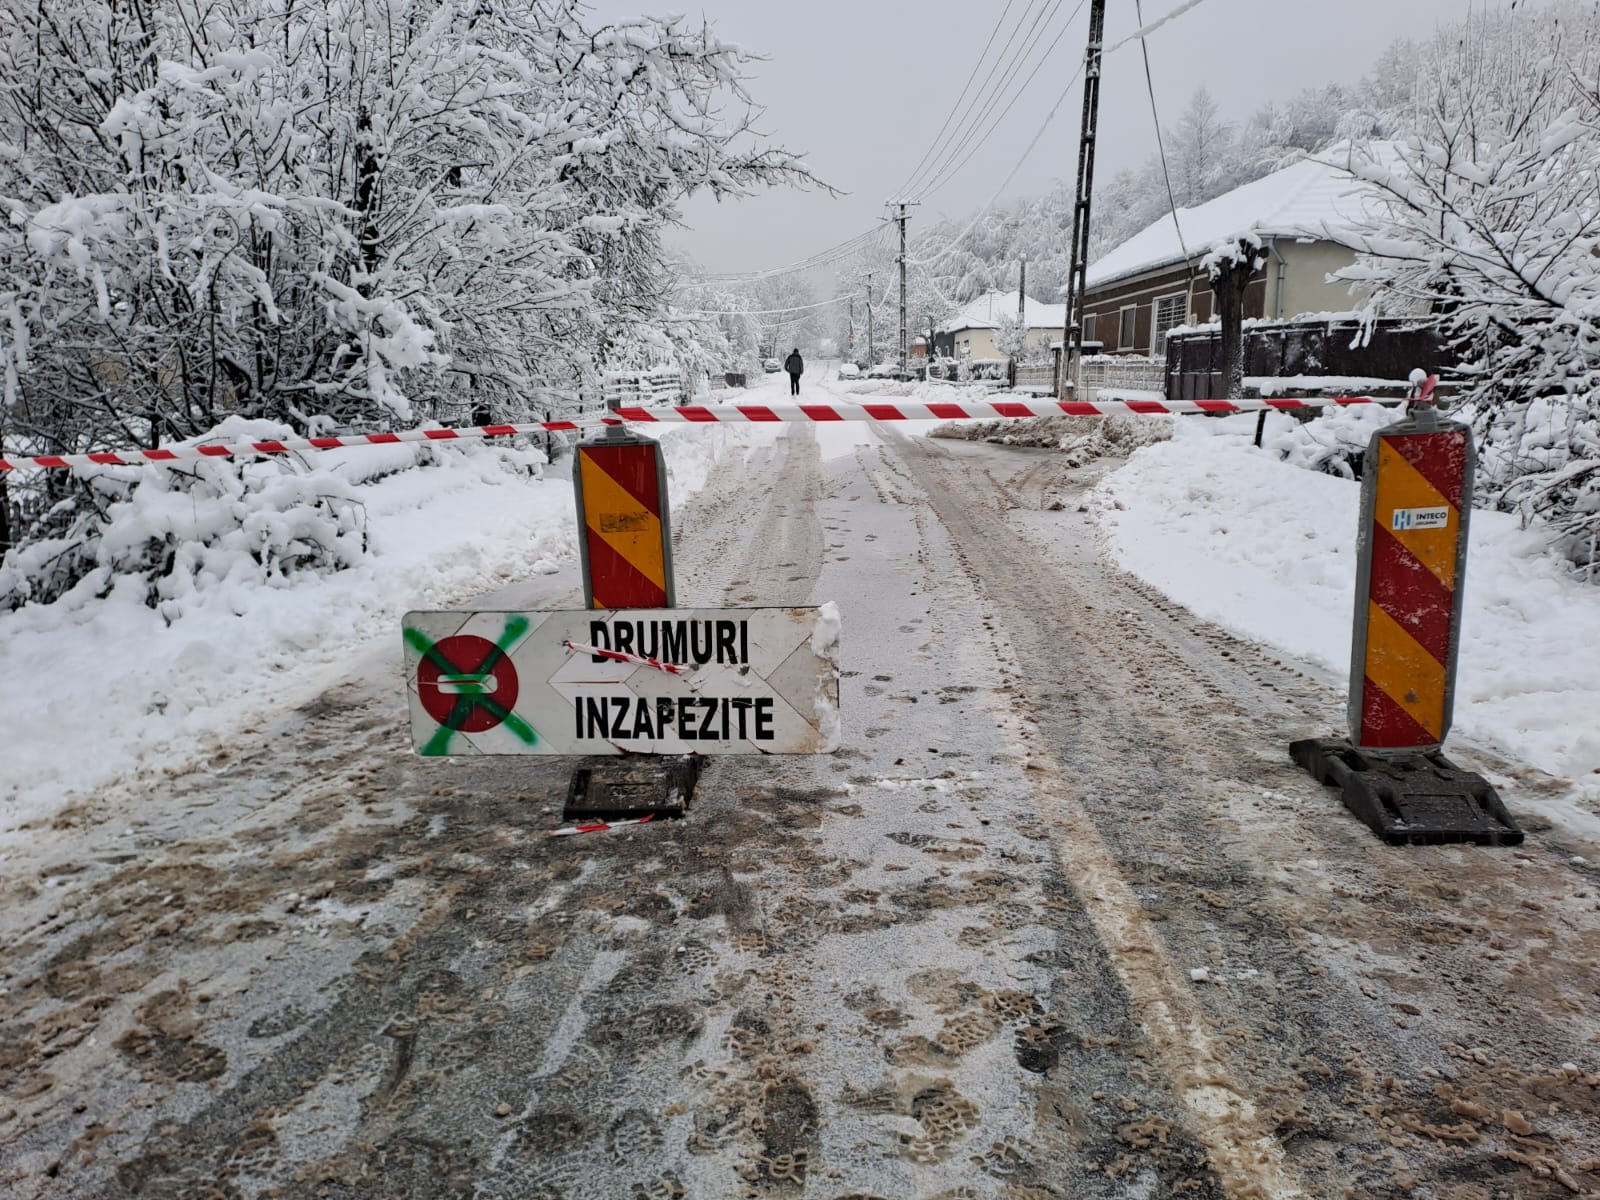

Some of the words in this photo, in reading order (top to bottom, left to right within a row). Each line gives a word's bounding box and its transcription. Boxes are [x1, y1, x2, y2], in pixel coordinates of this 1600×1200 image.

[1416, 512, 1447, 520] INTECO
[590, 620, 749, 665] DRUMURI
[575, 696, 775, 741] INZAPEZITE
